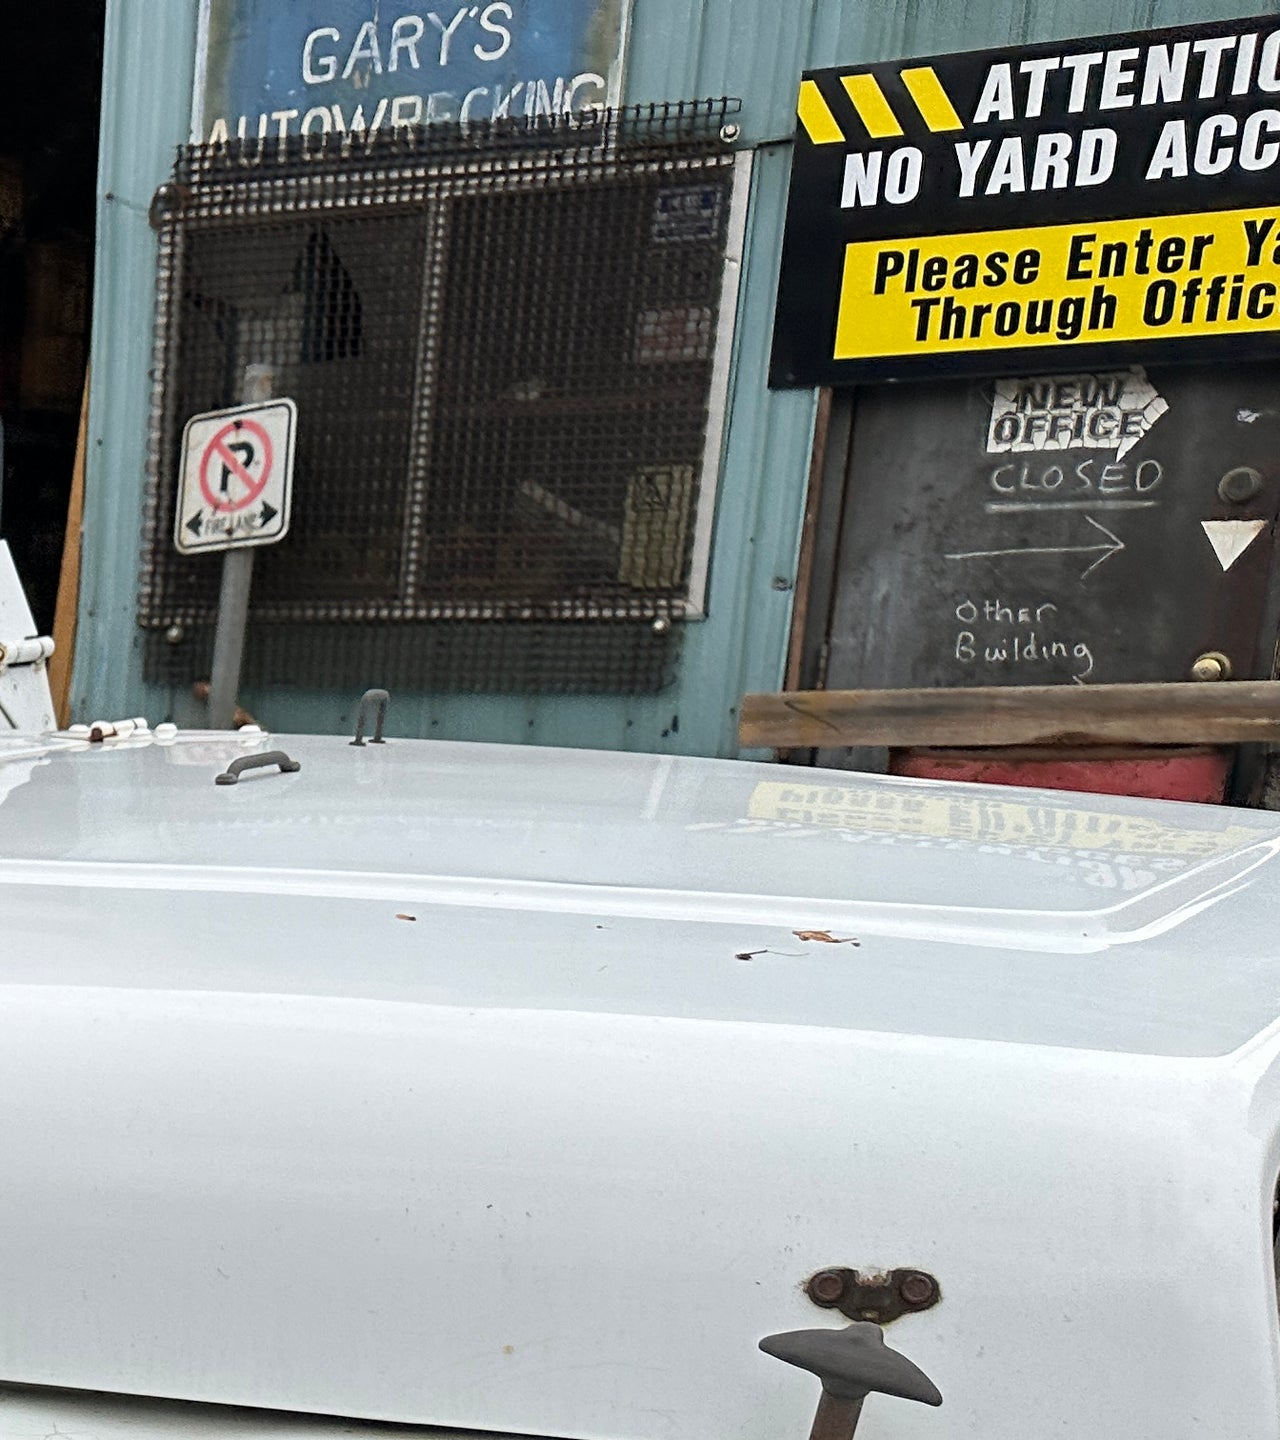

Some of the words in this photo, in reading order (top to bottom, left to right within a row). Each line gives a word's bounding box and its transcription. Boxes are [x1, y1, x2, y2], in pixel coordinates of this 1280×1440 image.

[302, 2, 513, 84] GARY'S
[840, 146, 924, 209] NO
[954, 127, 1118, 198] YARD
[1145, 109, 1280, 180] ACC
[874, 248, 1041, 295] Please
[1066, 229, 1214, 280] Enter
[911, 285, 1117, 341] Through
[1143, 274, 1277, 327] Offic
[1011, 380, 1124, 413] NEW
[993, 409, 1143, 444] OFFICE
[991, 459, 1163, 493] CLOSED
[955, 599, 1058, 625] Other
[955, 631, 1094, 686] Building
